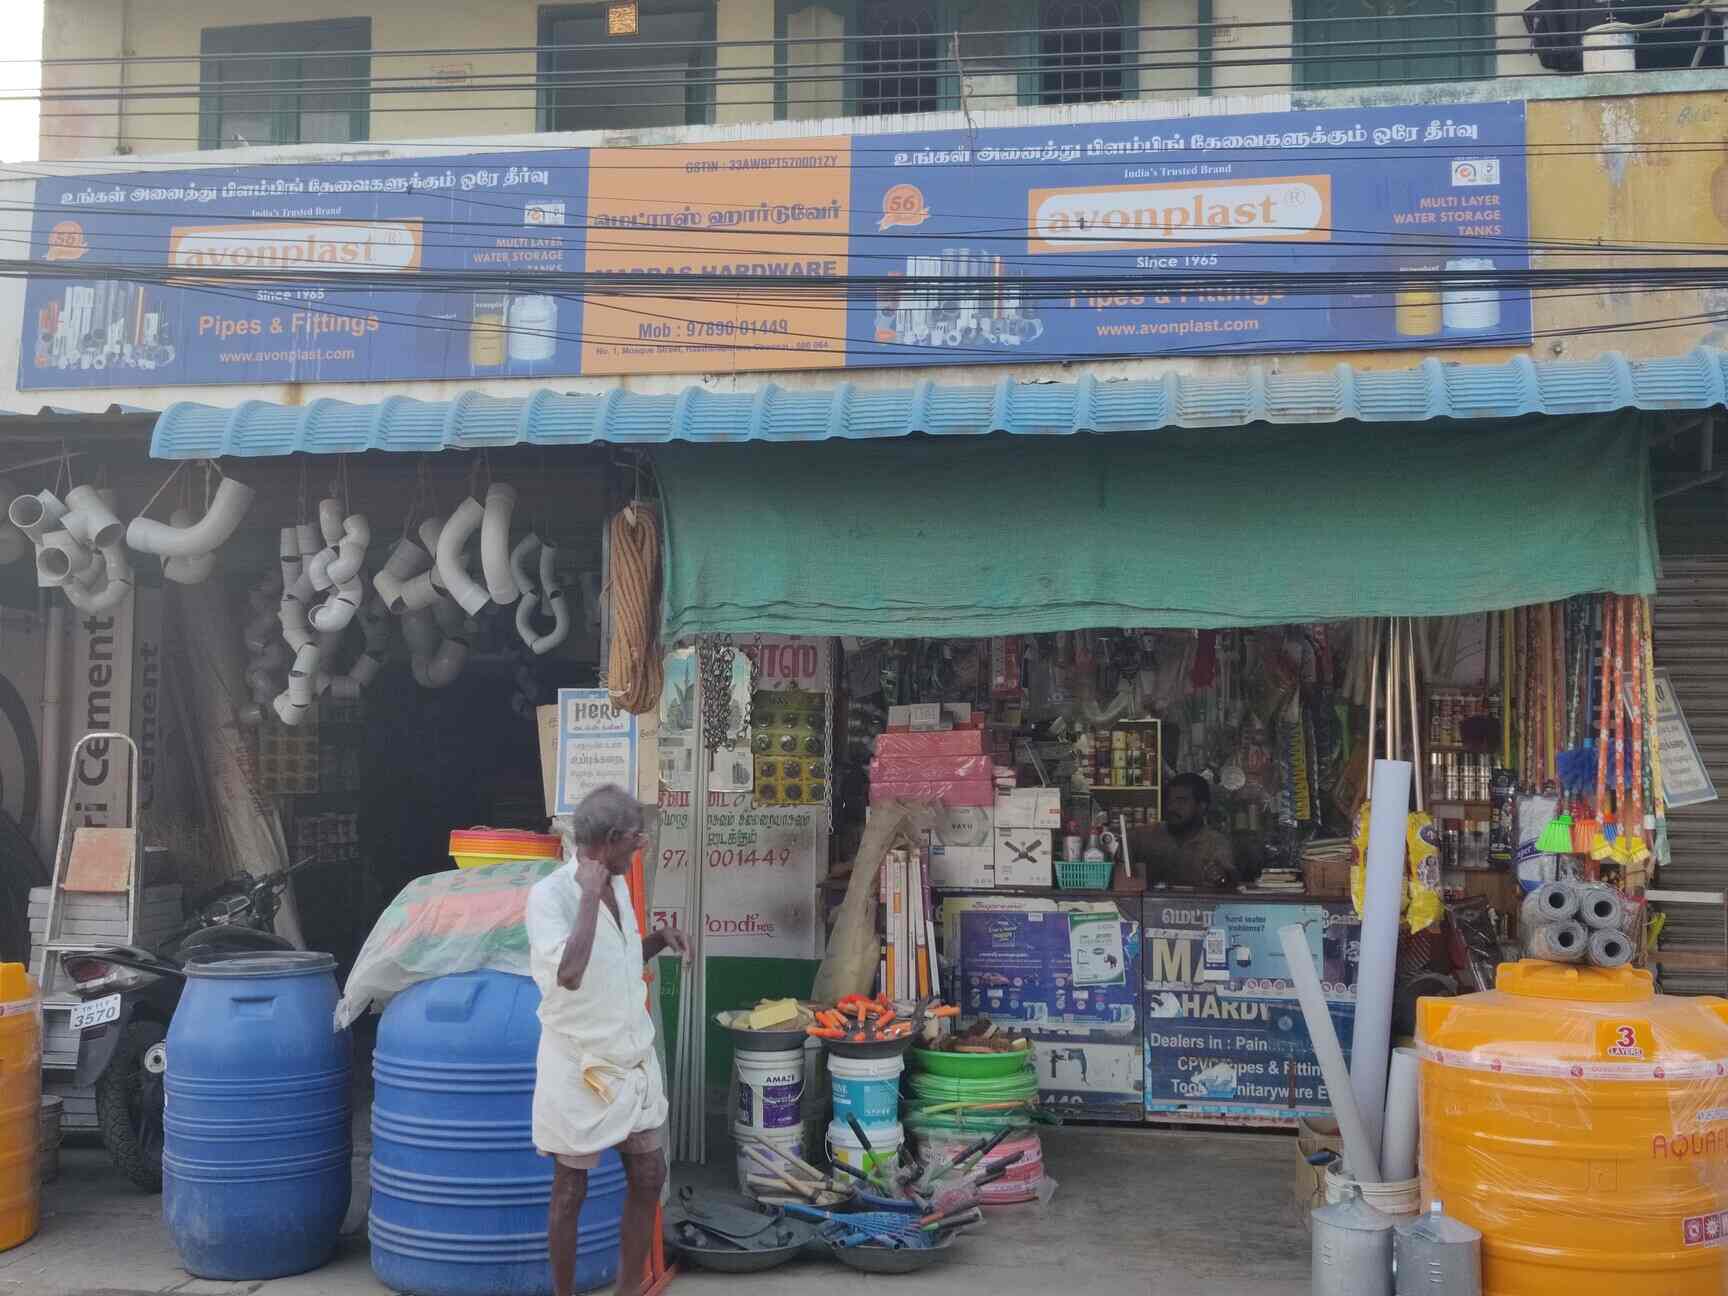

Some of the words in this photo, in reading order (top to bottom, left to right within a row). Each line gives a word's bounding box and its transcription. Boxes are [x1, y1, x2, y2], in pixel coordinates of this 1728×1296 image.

[1374, 124, 1417, 145] ஒரே
[1424, 120, 1478, 142] தீர்வு
[461, 170, 499, 190] ஒரே
[503, 167, 549, 187] தீர்வு
[1124, 168, 1157, 178] India's
[1160, 166, 1198, 177] Trusted
[1201, 164, 1231, 175] Brand
[1420, 197, 1458, 208] MULTI
[1462, 195, 1500, 206] LAYER
[1048, 193, 1279, 237] avonplast
[1393, 213, 1437, 224] WATER
[1440, 211, 1501, 222] STORAGE
[1458, 226, 1502, 237] TANKS
[184, 232, 371, 270] avonplast
[474, 252, 510, 264] WATER
[512, 251, 563, 262] STORAGE
[1136, 256, 1178, 268] Since
[1184, 254, 1218, 267] 1965
[257, 289, 291, 301] Since
[199, 315, 261, 338] Pipes
[270, 317, 283, 333] &
[291, 311, 379, 336] Fittings
[639, 322, 671, 340] Mob
[739, 319, 788, 336] 01449
[1096, 318, 1259, 336] www.avonplast.com
[220, 347, 355, 363] www.avonplast.com
[78, 615, 114, 786] Cement
[75, 1007, 116, 1027] 3570
[1150, 1033, 1204, 1049] Dealers
[1209, 1035, 1222, 1049] in
[1236, 1036, 1268, 1051] Pain
[1617, 1026, 1635, 1048] 3
[1268, 1060, 1280, 1074] &
